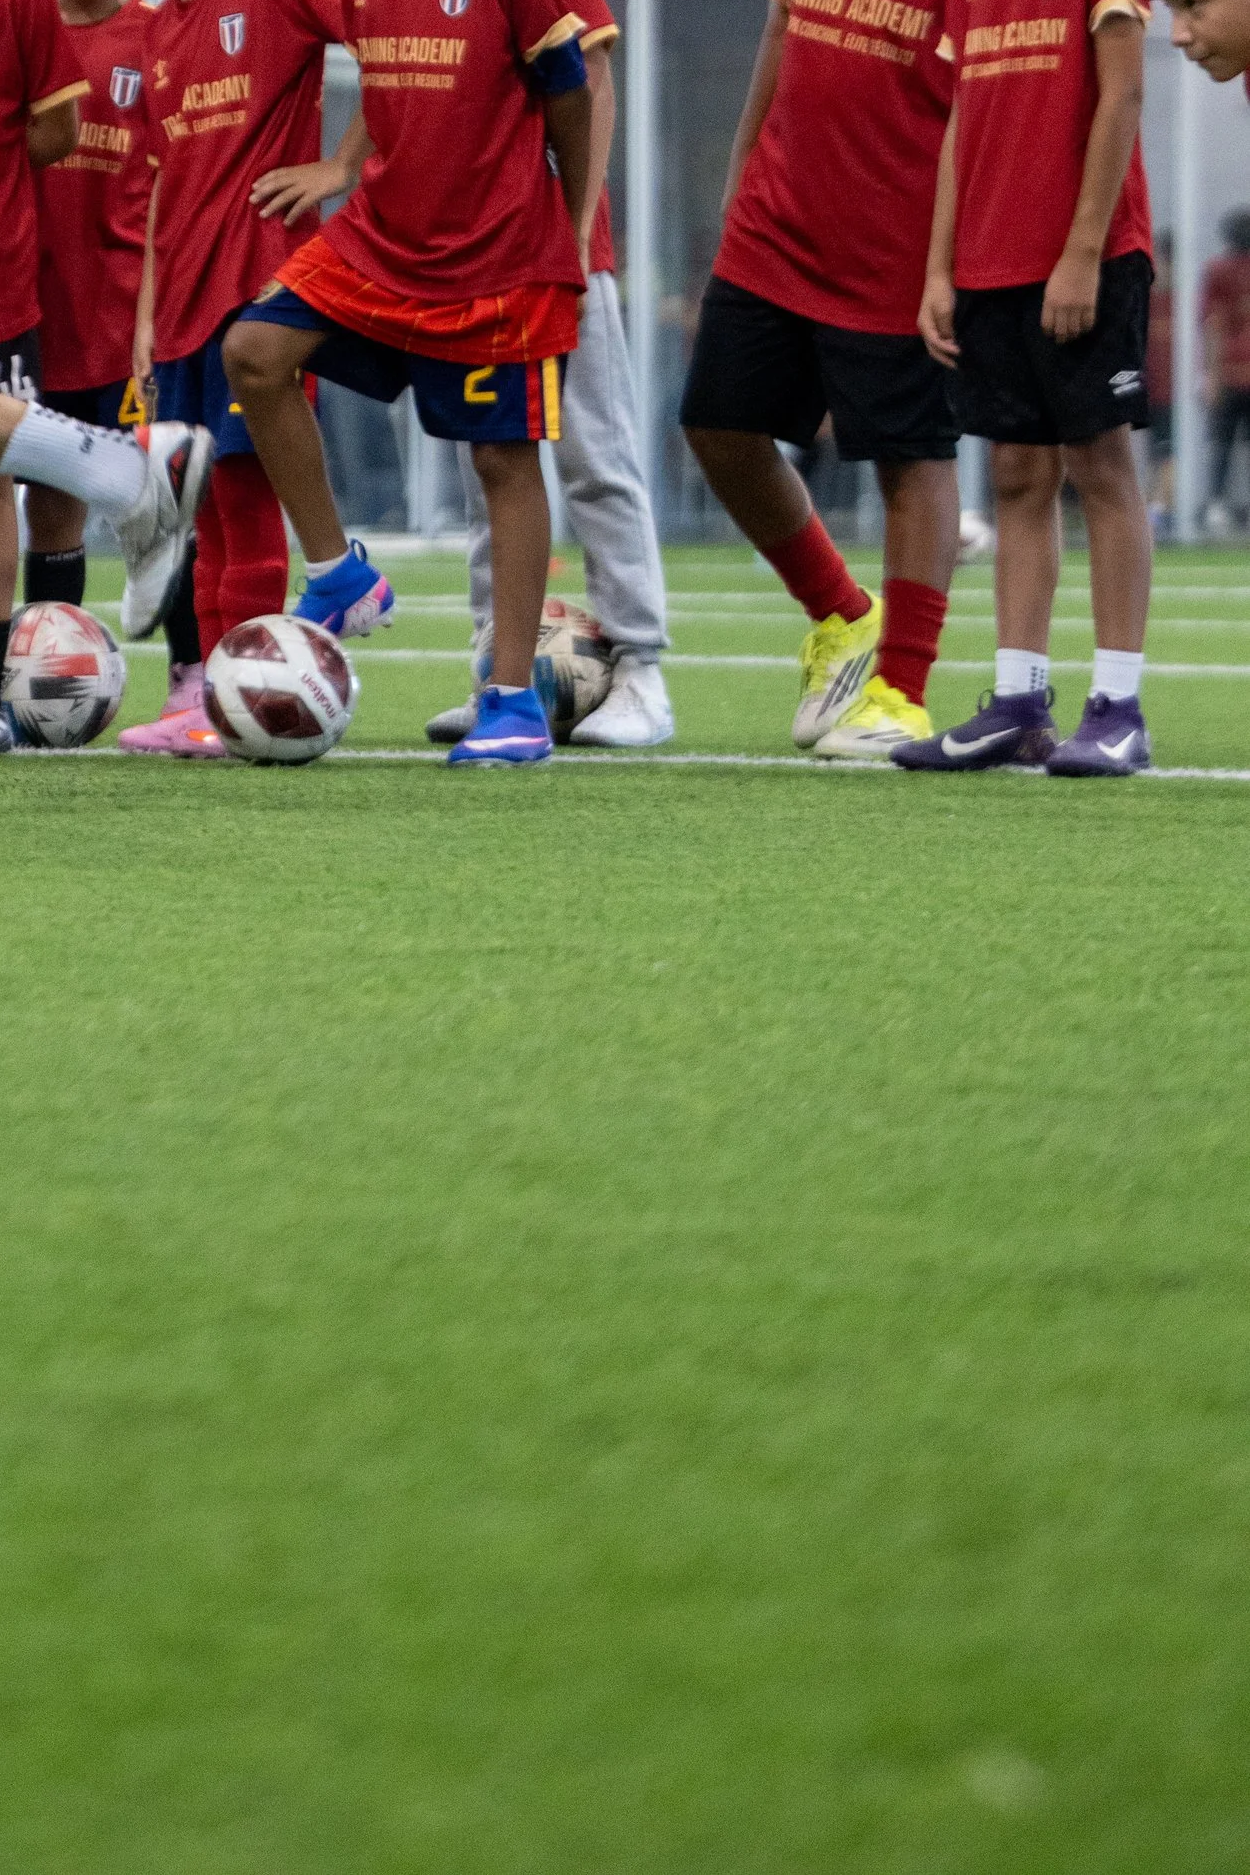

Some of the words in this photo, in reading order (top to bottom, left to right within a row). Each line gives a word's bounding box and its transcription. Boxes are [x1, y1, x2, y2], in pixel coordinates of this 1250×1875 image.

[78, 121, 131, 154] ADEMY
[117, 376, 147, 426] 4
[464, 365, 498, 403] 2
[301, 673, 336, 719] molten
